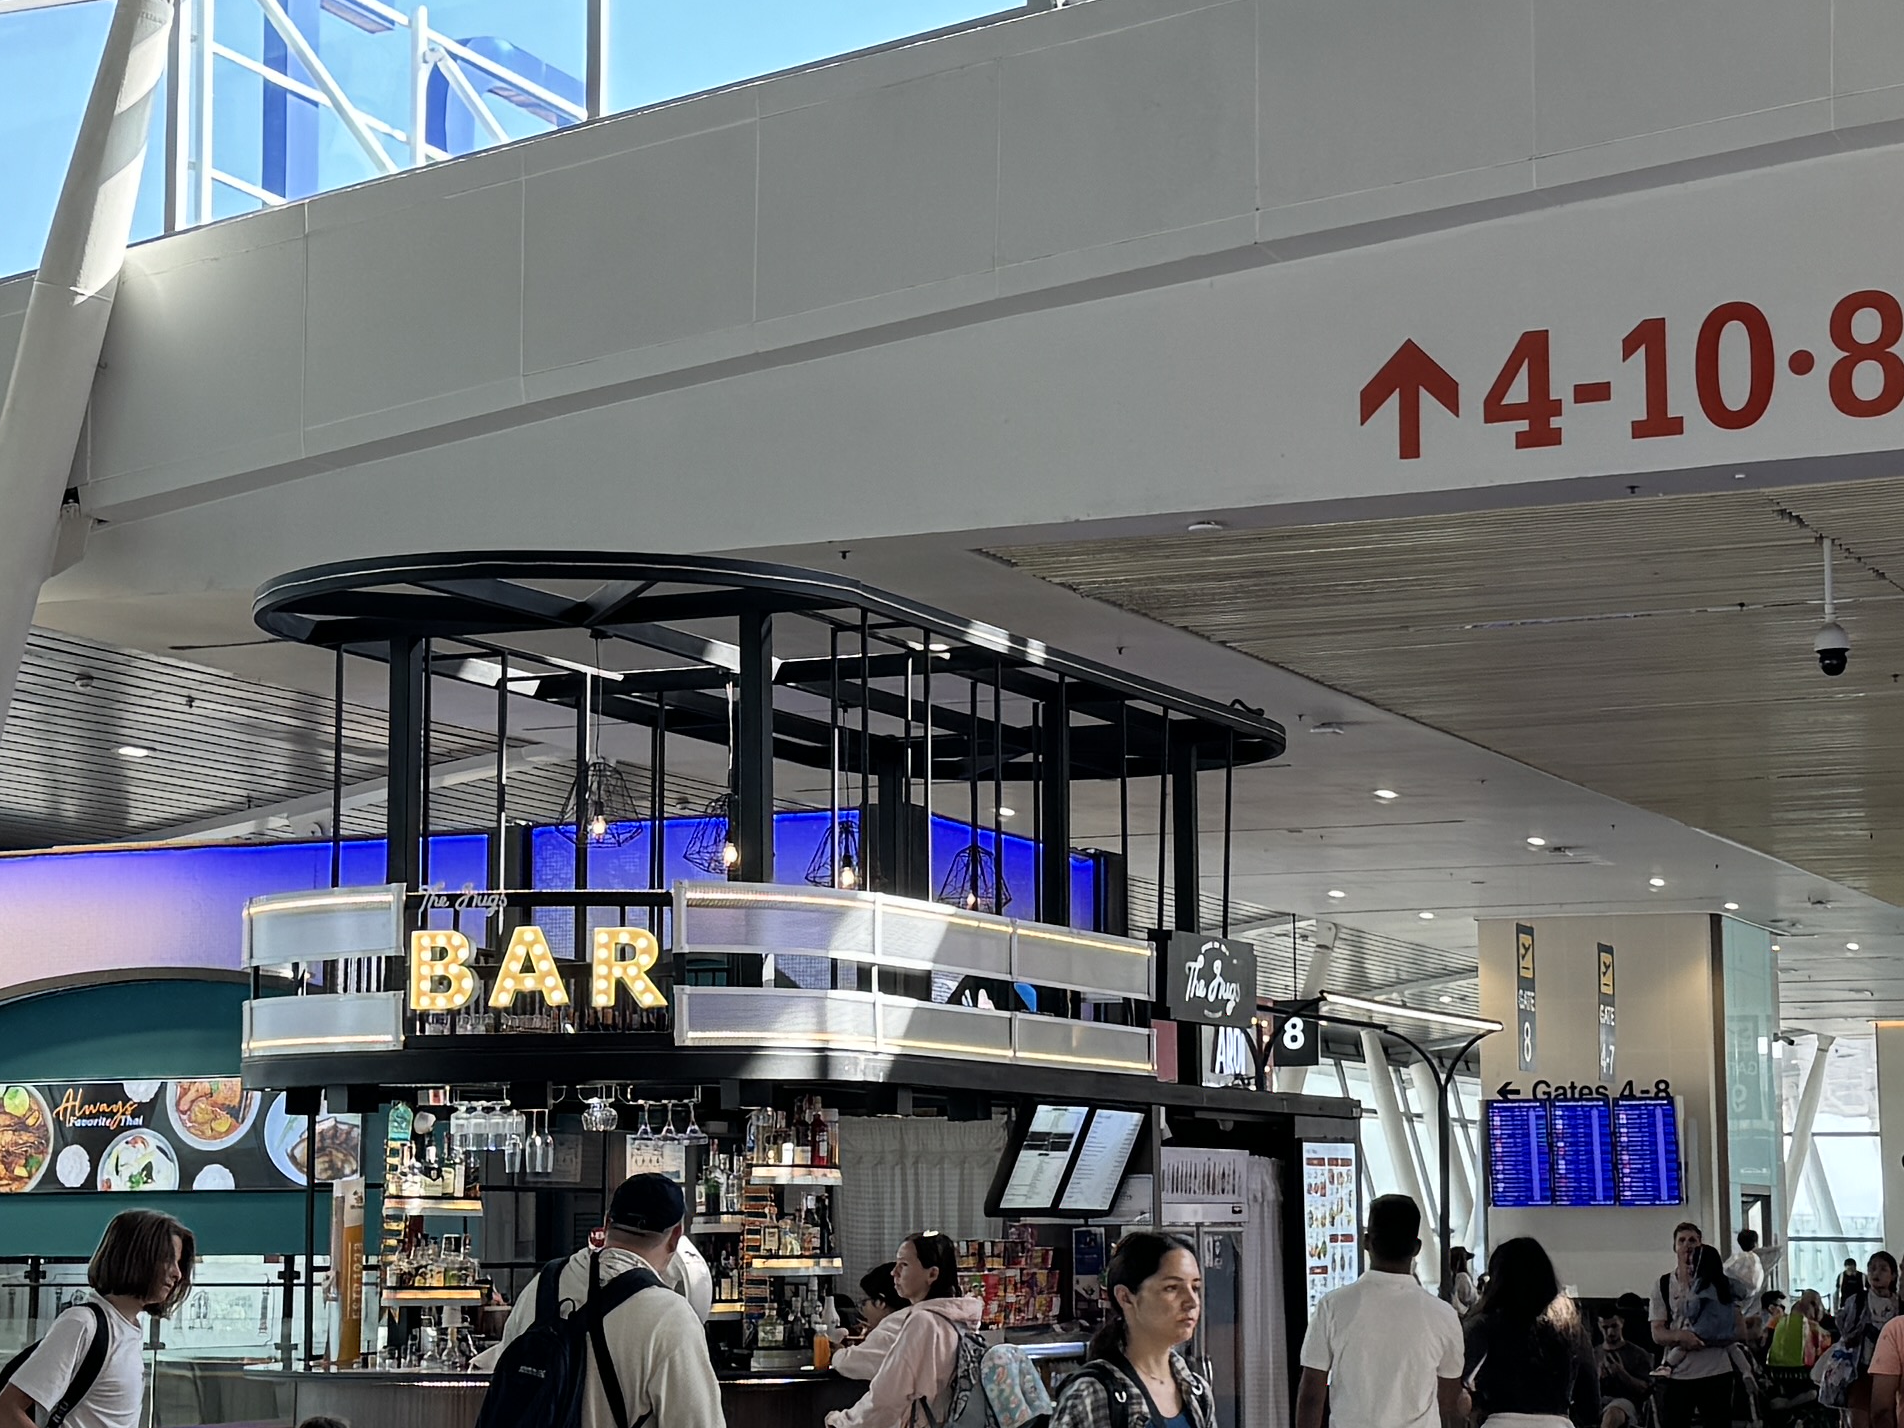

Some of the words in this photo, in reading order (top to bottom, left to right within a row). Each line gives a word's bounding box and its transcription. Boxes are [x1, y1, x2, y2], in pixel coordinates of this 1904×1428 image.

[418, 881, 450, 913] The
[410, 925, 669, 1011] BAR
[1185, 954, 1207, 1002] The
[1283, 1016, 1305, 1050] 8
[1523, 1022, 1532, 1063] 8
[53, 1087, 138, 1130] Always
[1532, 1079, 1609, 1100] Gates
